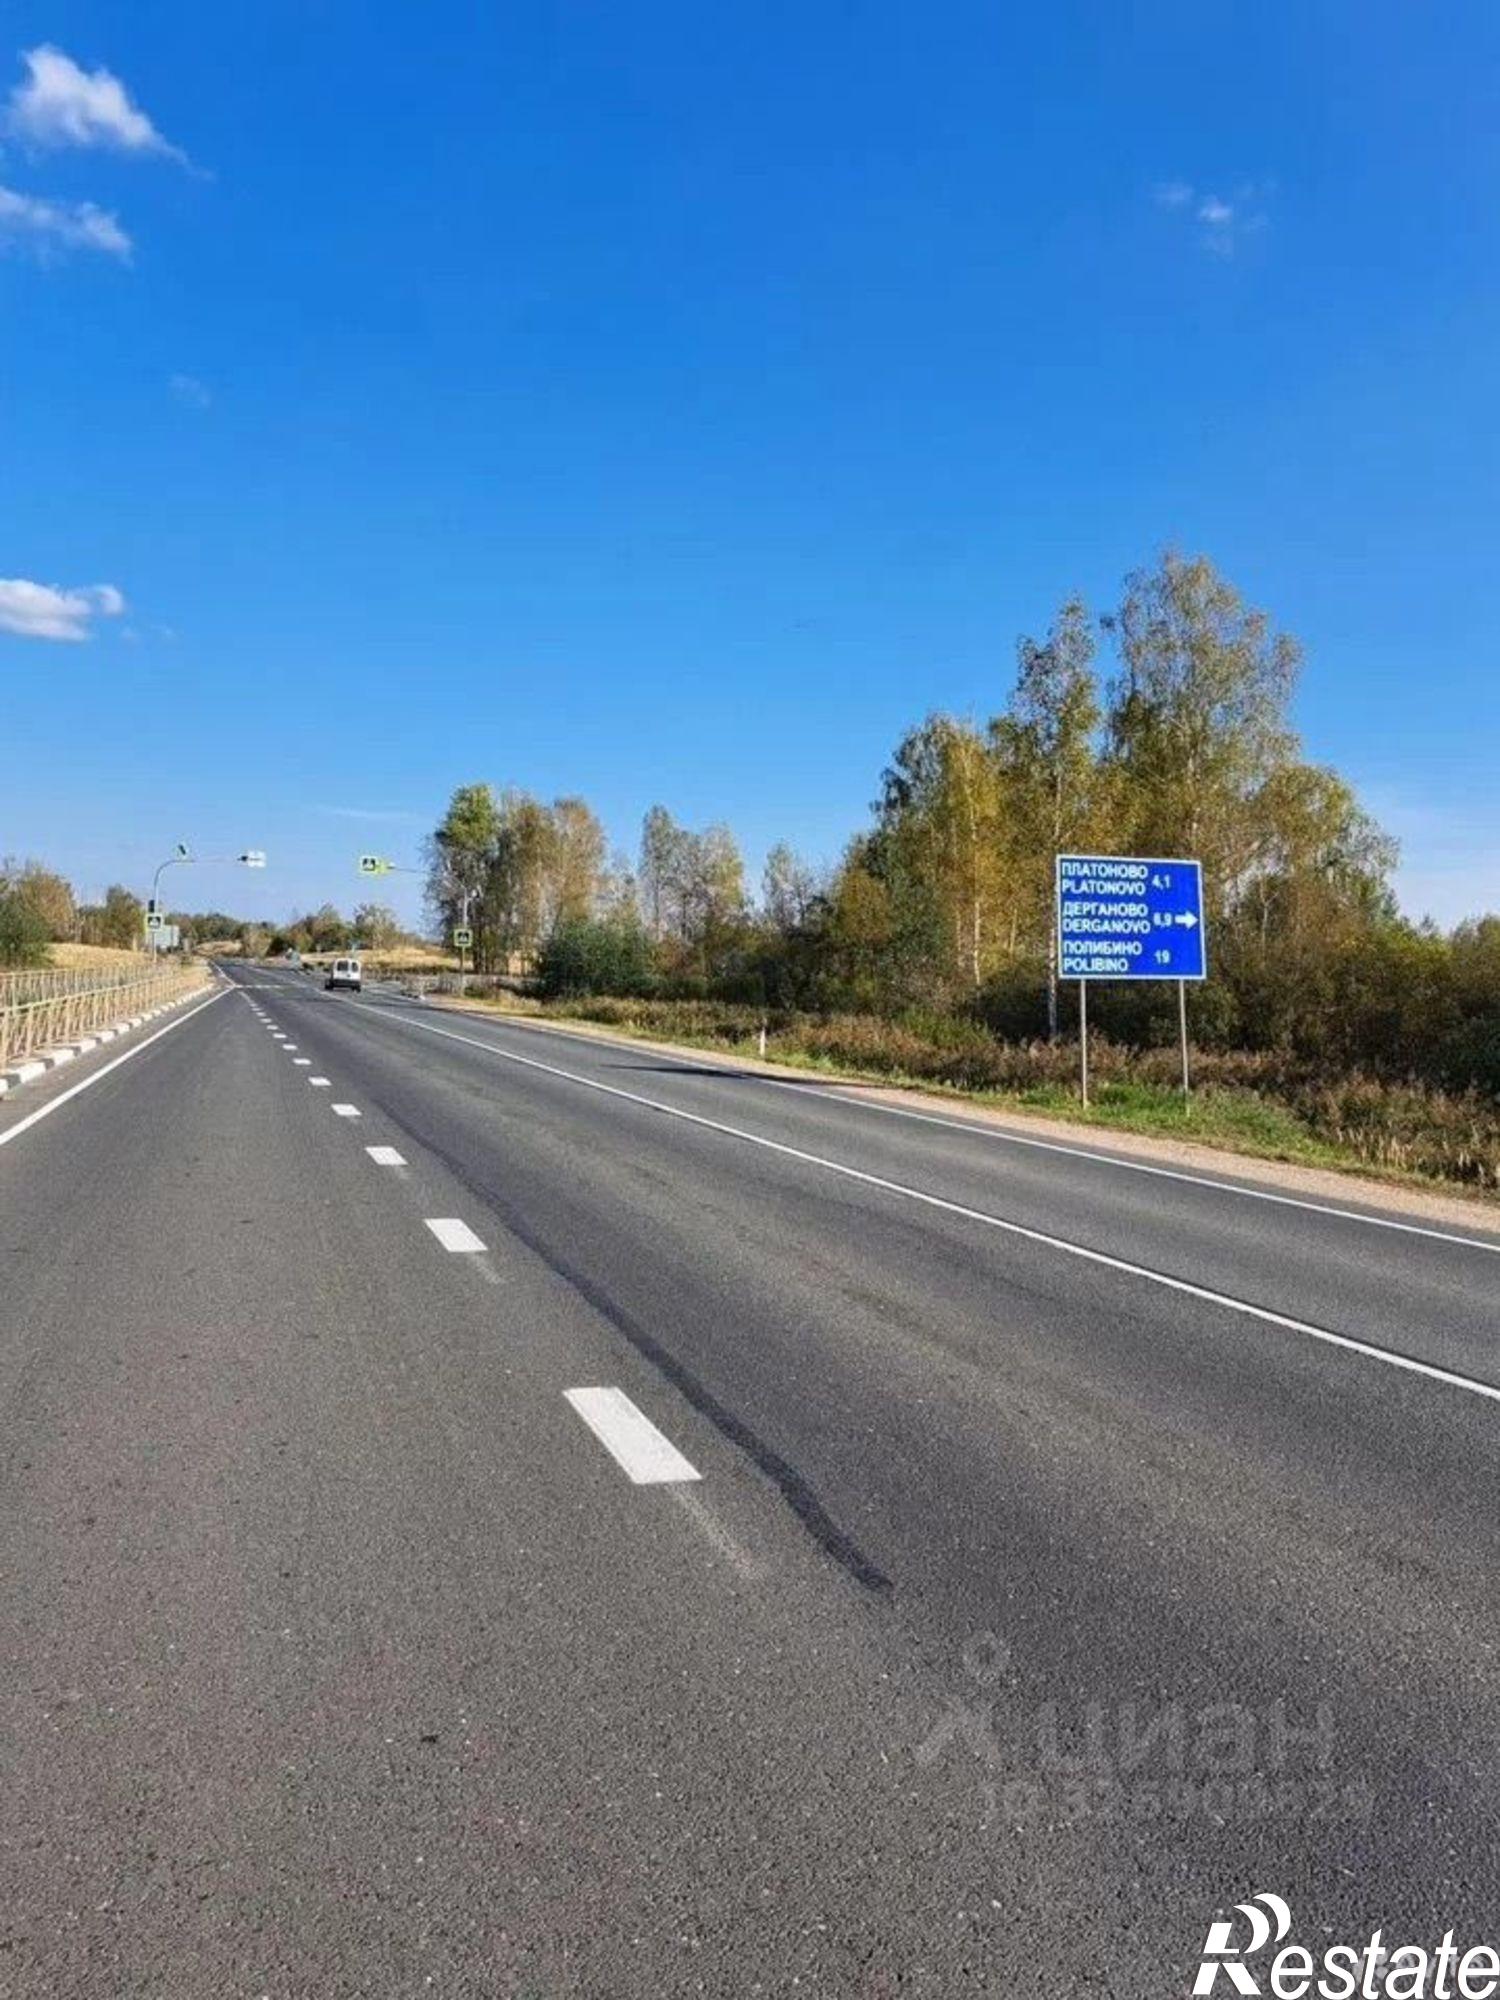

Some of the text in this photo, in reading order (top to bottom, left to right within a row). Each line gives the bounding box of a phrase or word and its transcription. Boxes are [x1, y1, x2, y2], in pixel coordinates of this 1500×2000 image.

[1062, 863, 1148, 878] ПЛАТОНОВО
[1062, 879, 1146, 895] PLATONOVO
[1063, 901, 1148, 917] ДЕРГАНОВО
[1062, 919, 1150, 933] DERGANOVO
[1063, 940, 1143, 955] ПОЛИБИНО
[1063, 957, 1129, 972] POLIBINO
[1154, 950, 1171, 964] 19
